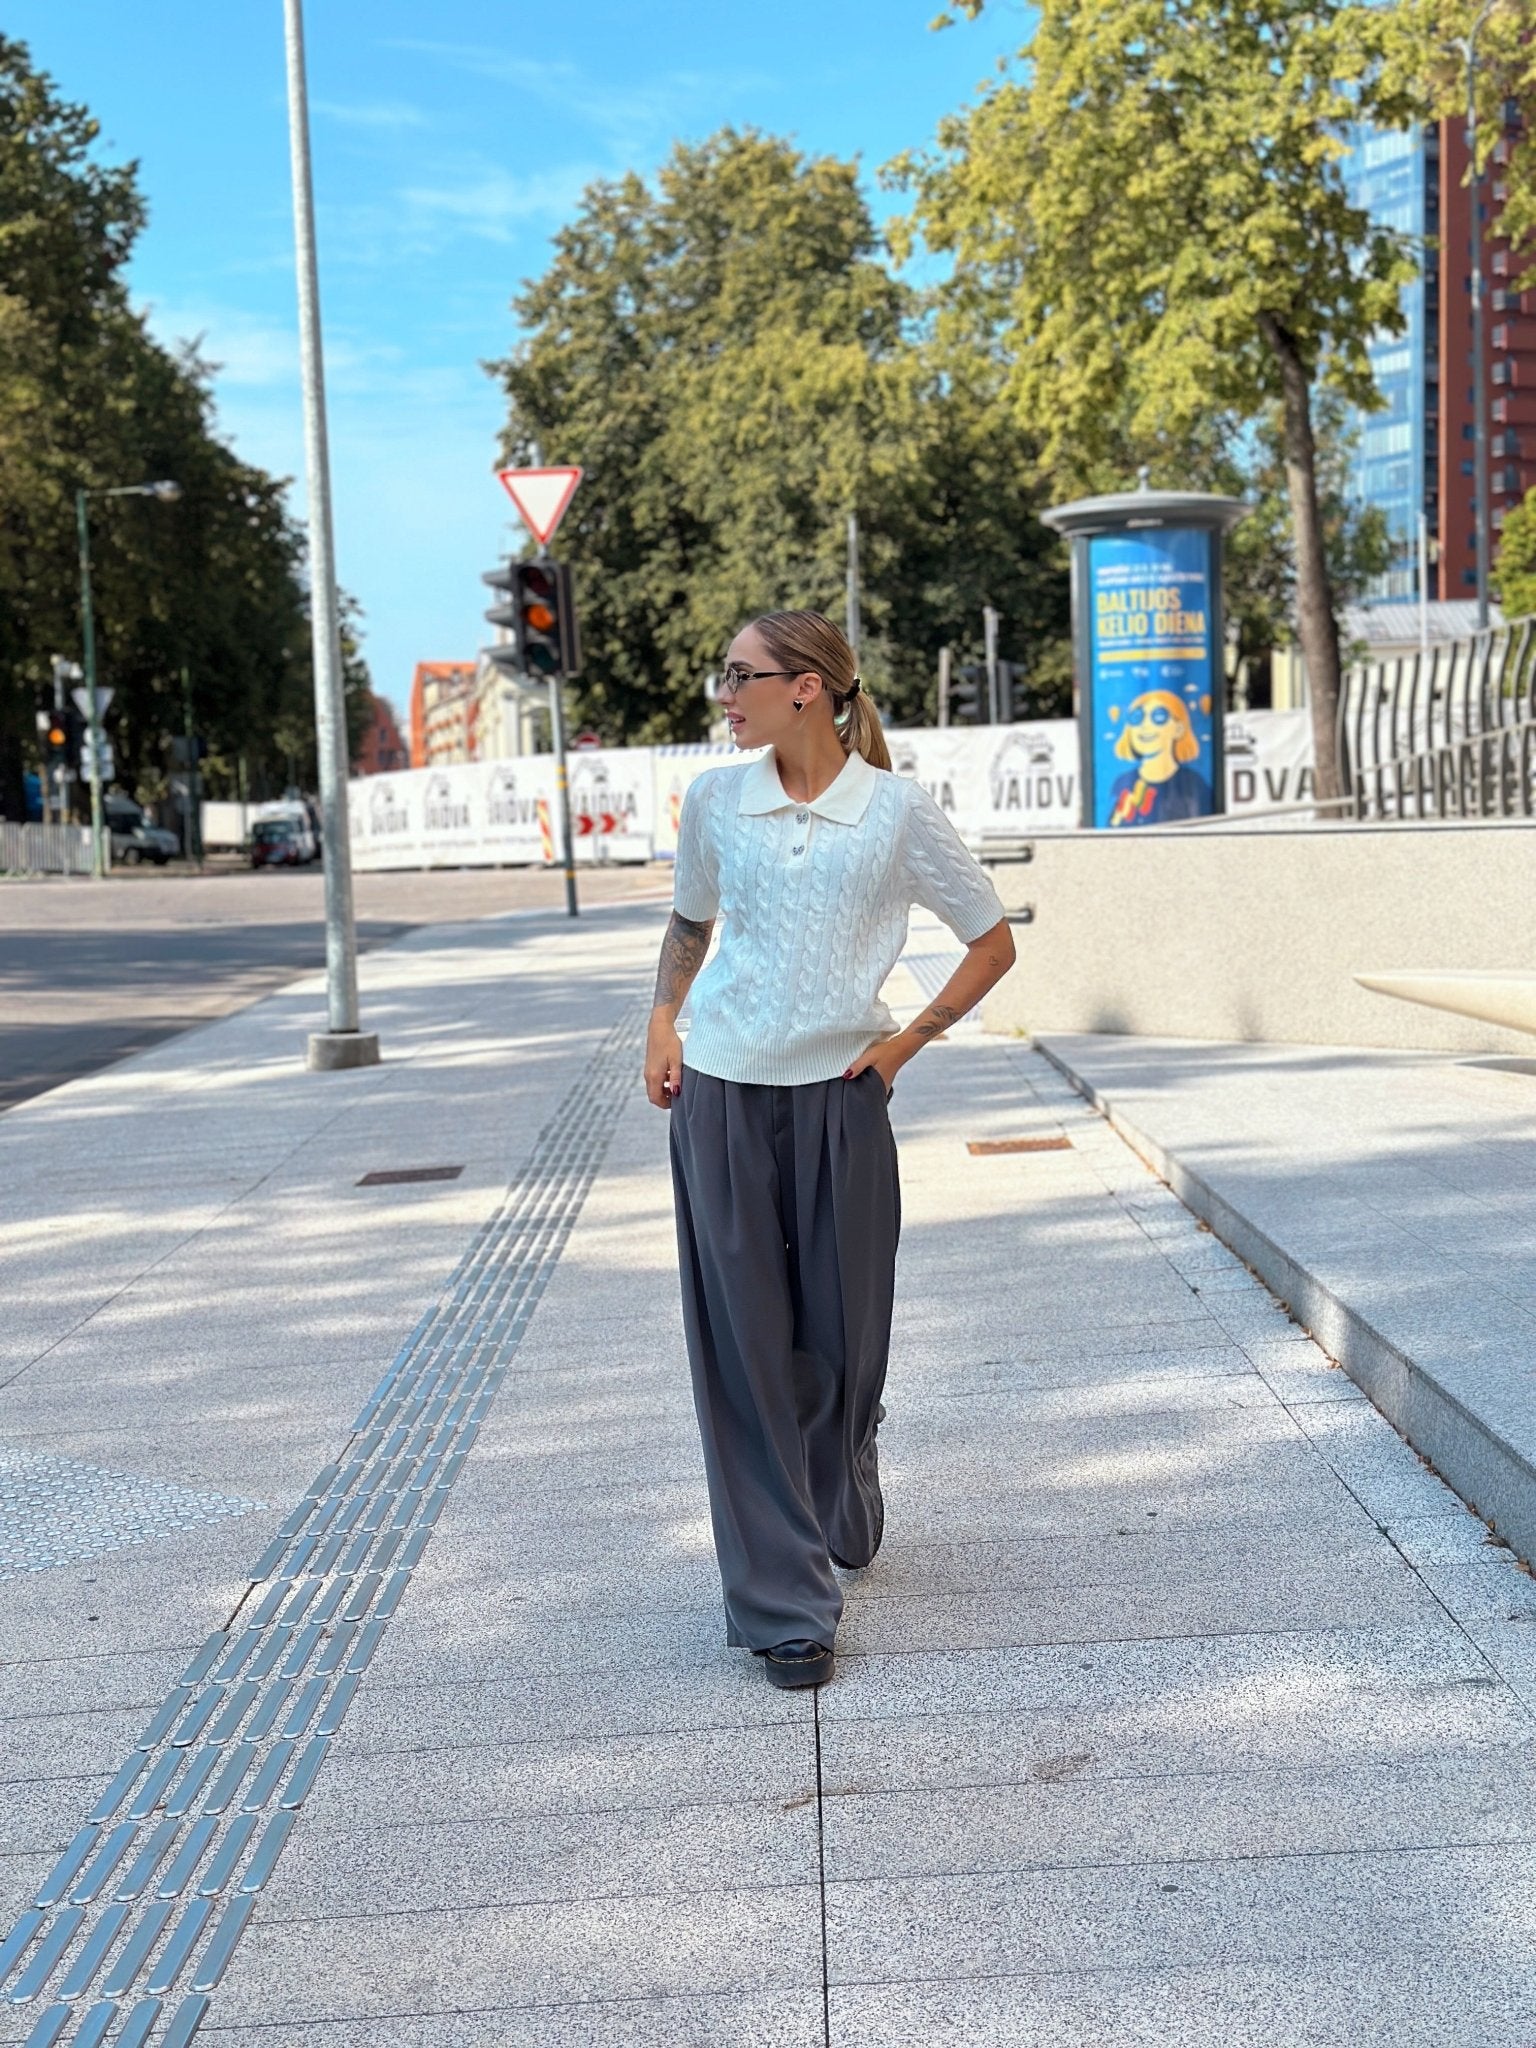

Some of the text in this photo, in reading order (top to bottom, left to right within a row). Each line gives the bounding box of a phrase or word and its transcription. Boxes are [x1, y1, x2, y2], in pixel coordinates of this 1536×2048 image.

[1097, 610, 1206, 637] KELIO DIENA
[991, 774, 1074, 811] VAIDV
[1233, 767, 1315, 803] DVA
